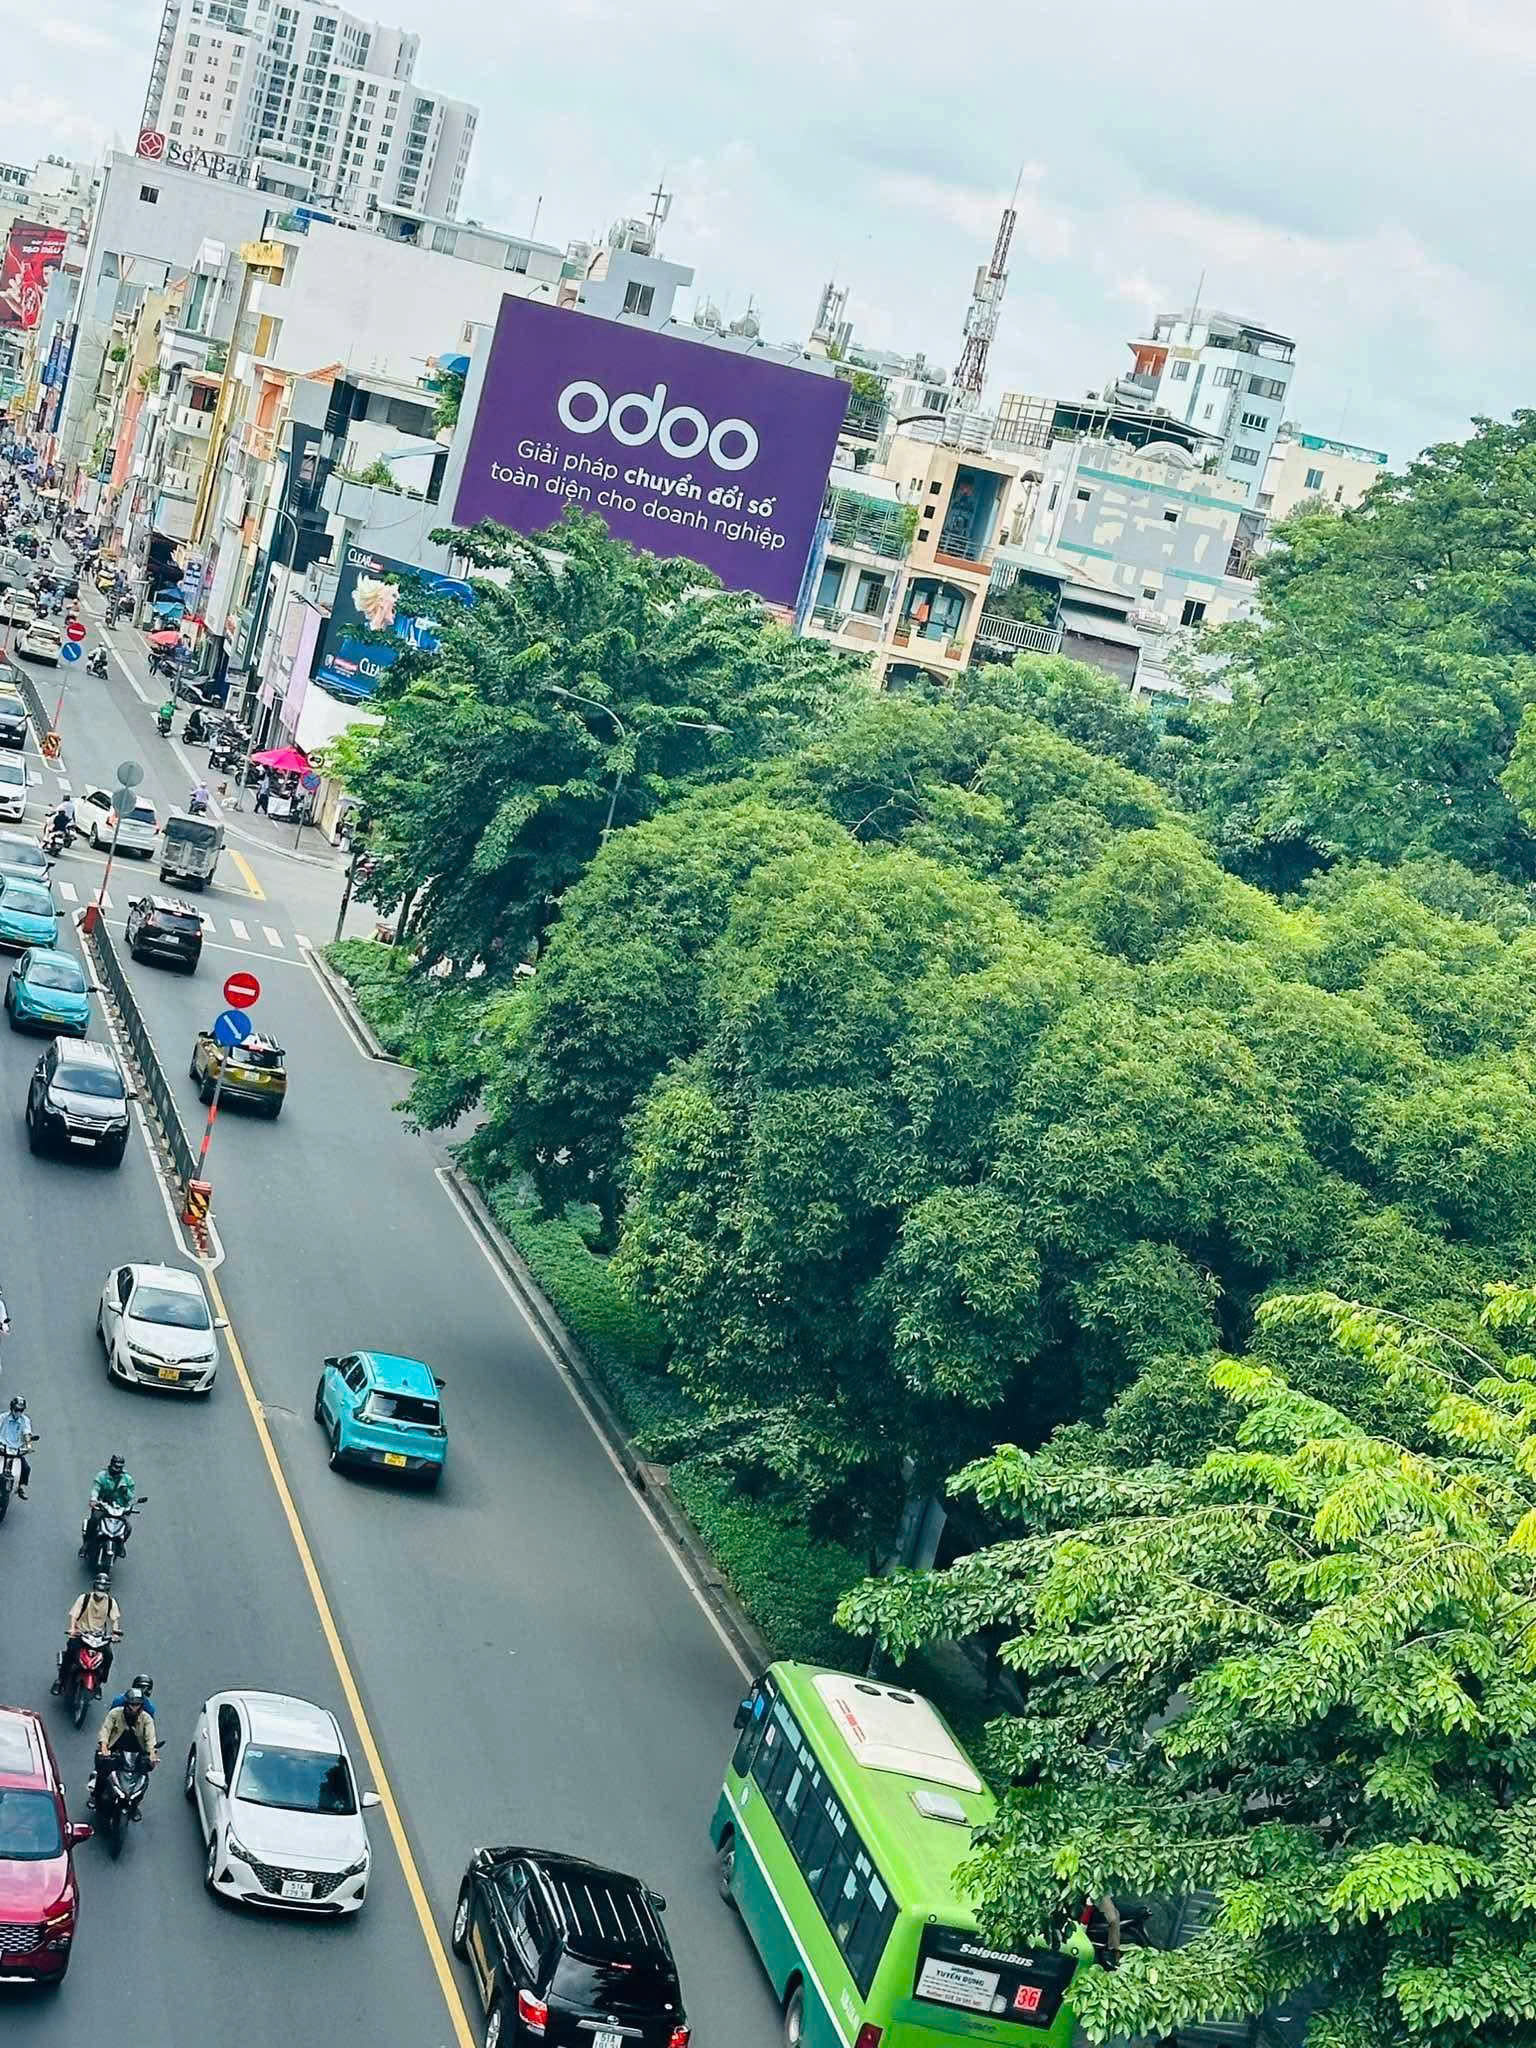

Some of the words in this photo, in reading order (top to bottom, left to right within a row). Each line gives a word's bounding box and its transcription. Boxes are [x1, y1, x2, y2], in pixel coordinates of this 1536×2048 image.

[558, 380, 759, 471] odoo
[491, 462, 540, 489] toàn
[545, 475, 592, 503] diện
[597, 489, 637, 512] cho
[642, 500, 709, 531] doanh
[714, 519, 786, 550] nghiệp
[517, 440, 560, 465] Giải
[563, 453, 619, 481] pháp
[624, 467, 702, 500] chuyển
[707, 485, 744, 510] đổi
[747, 497, 777, 517] số
[960, 1943, 1034, 1968] SaigonBus
[1017, 1988, 1038, 2008] 36
